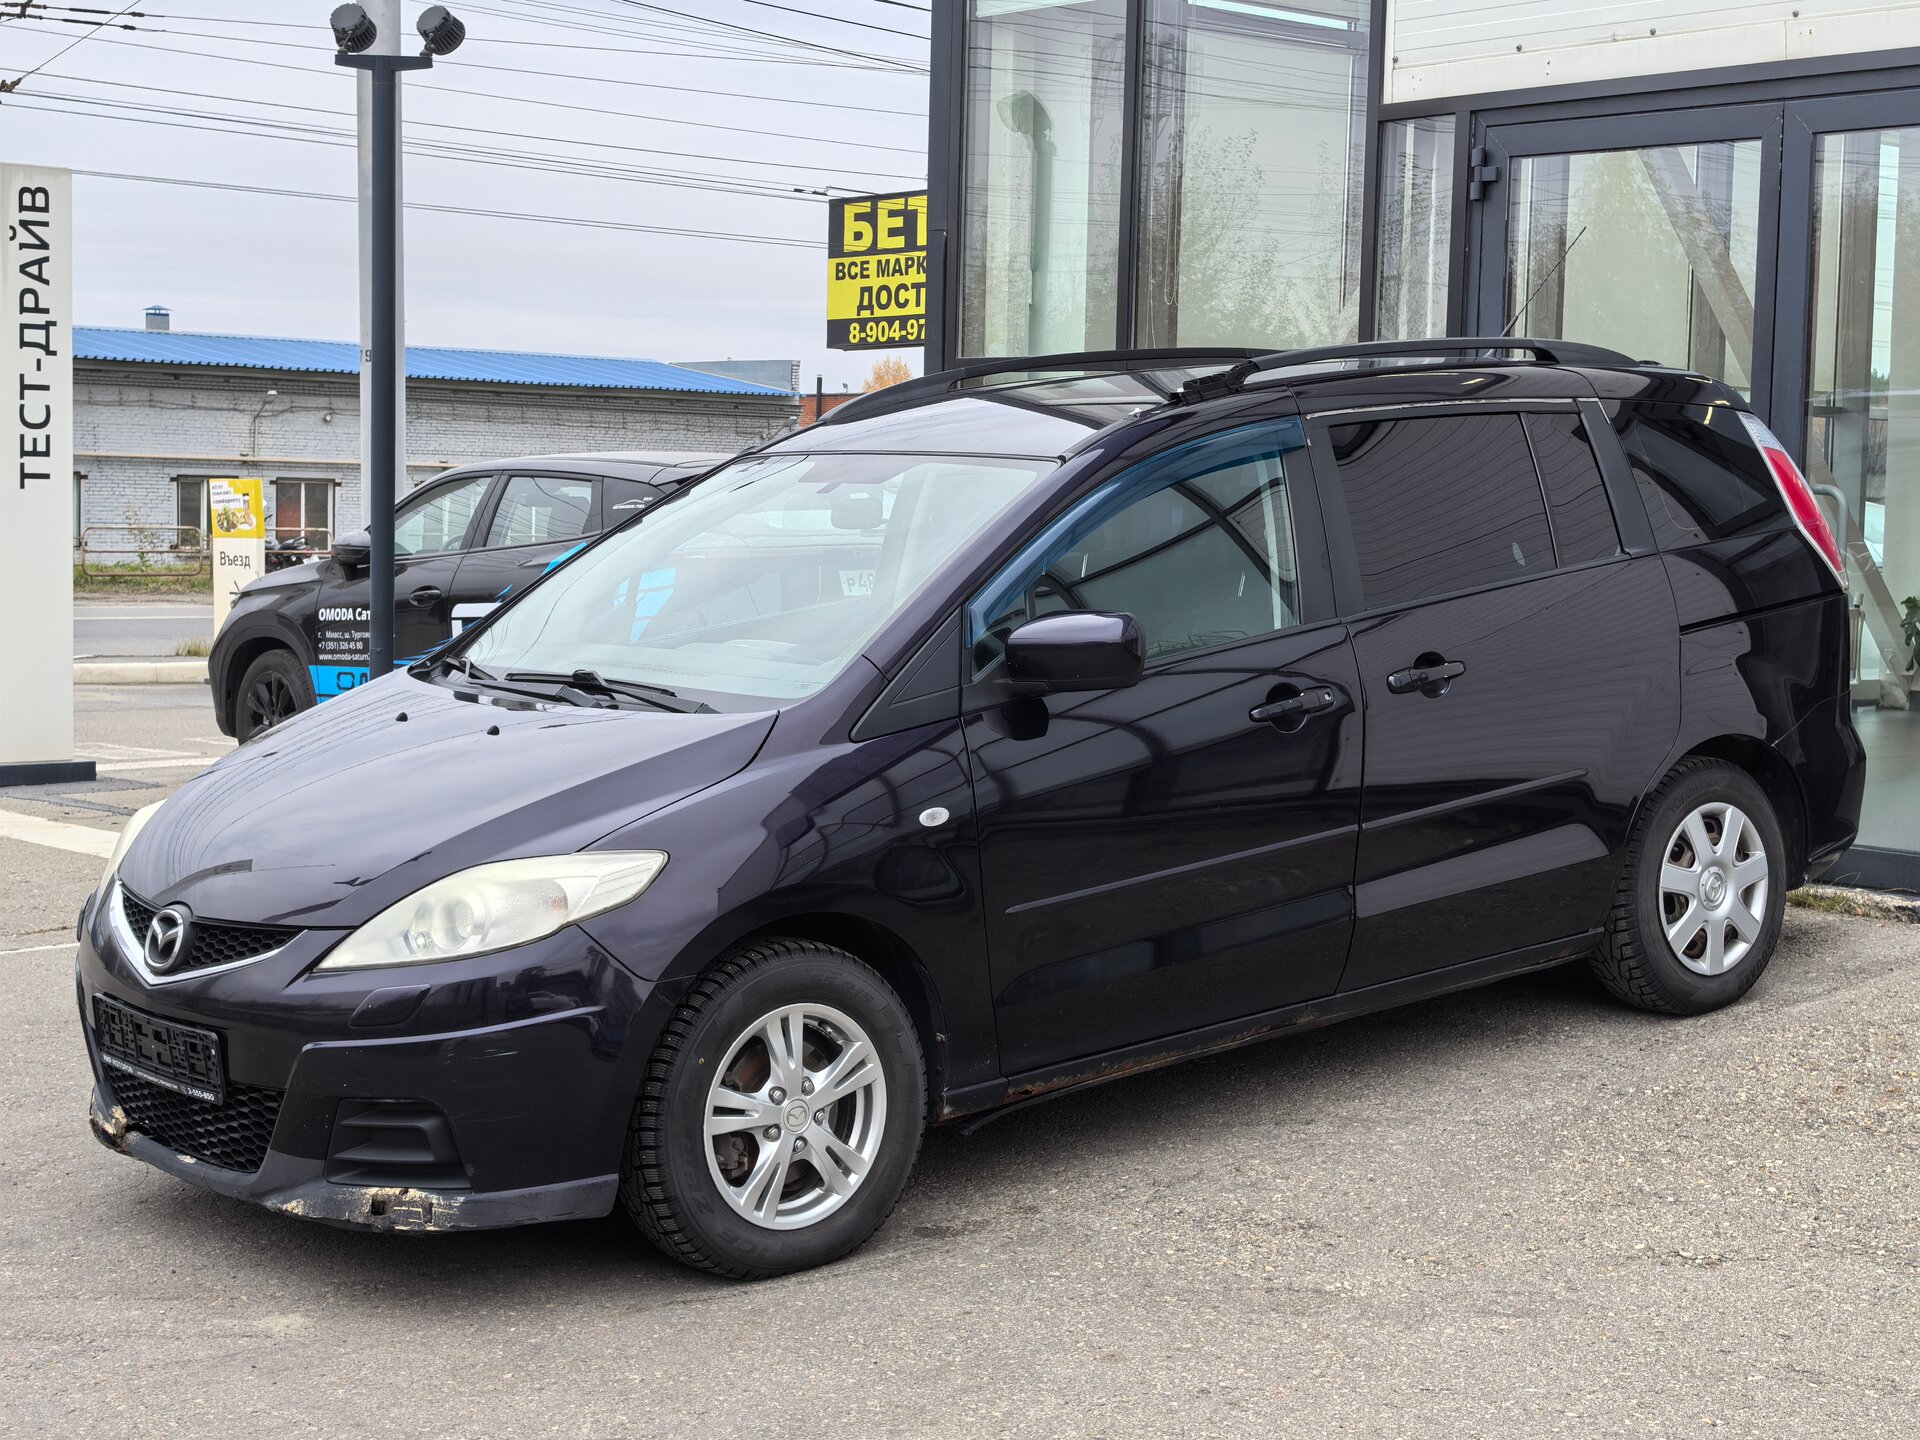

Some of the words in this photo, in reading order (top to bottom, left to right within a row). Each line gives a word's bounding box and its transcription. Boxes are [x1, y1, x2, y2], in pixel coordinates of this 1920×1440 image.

[835, 260, 870, 281] ВСЕ
[876, 256, 927, 278] МАРК
[856, 282, 926, 316] ДОСТ
[9, 186, 58, 490] ТЕСТ-ДРАЙВ
[848, 319, 926, 344] 8-904-97
[219, 551, 251, 570] Въезд
[318, 608, 354, 621] OMODA
[325, 642, 339, 650] (351)
